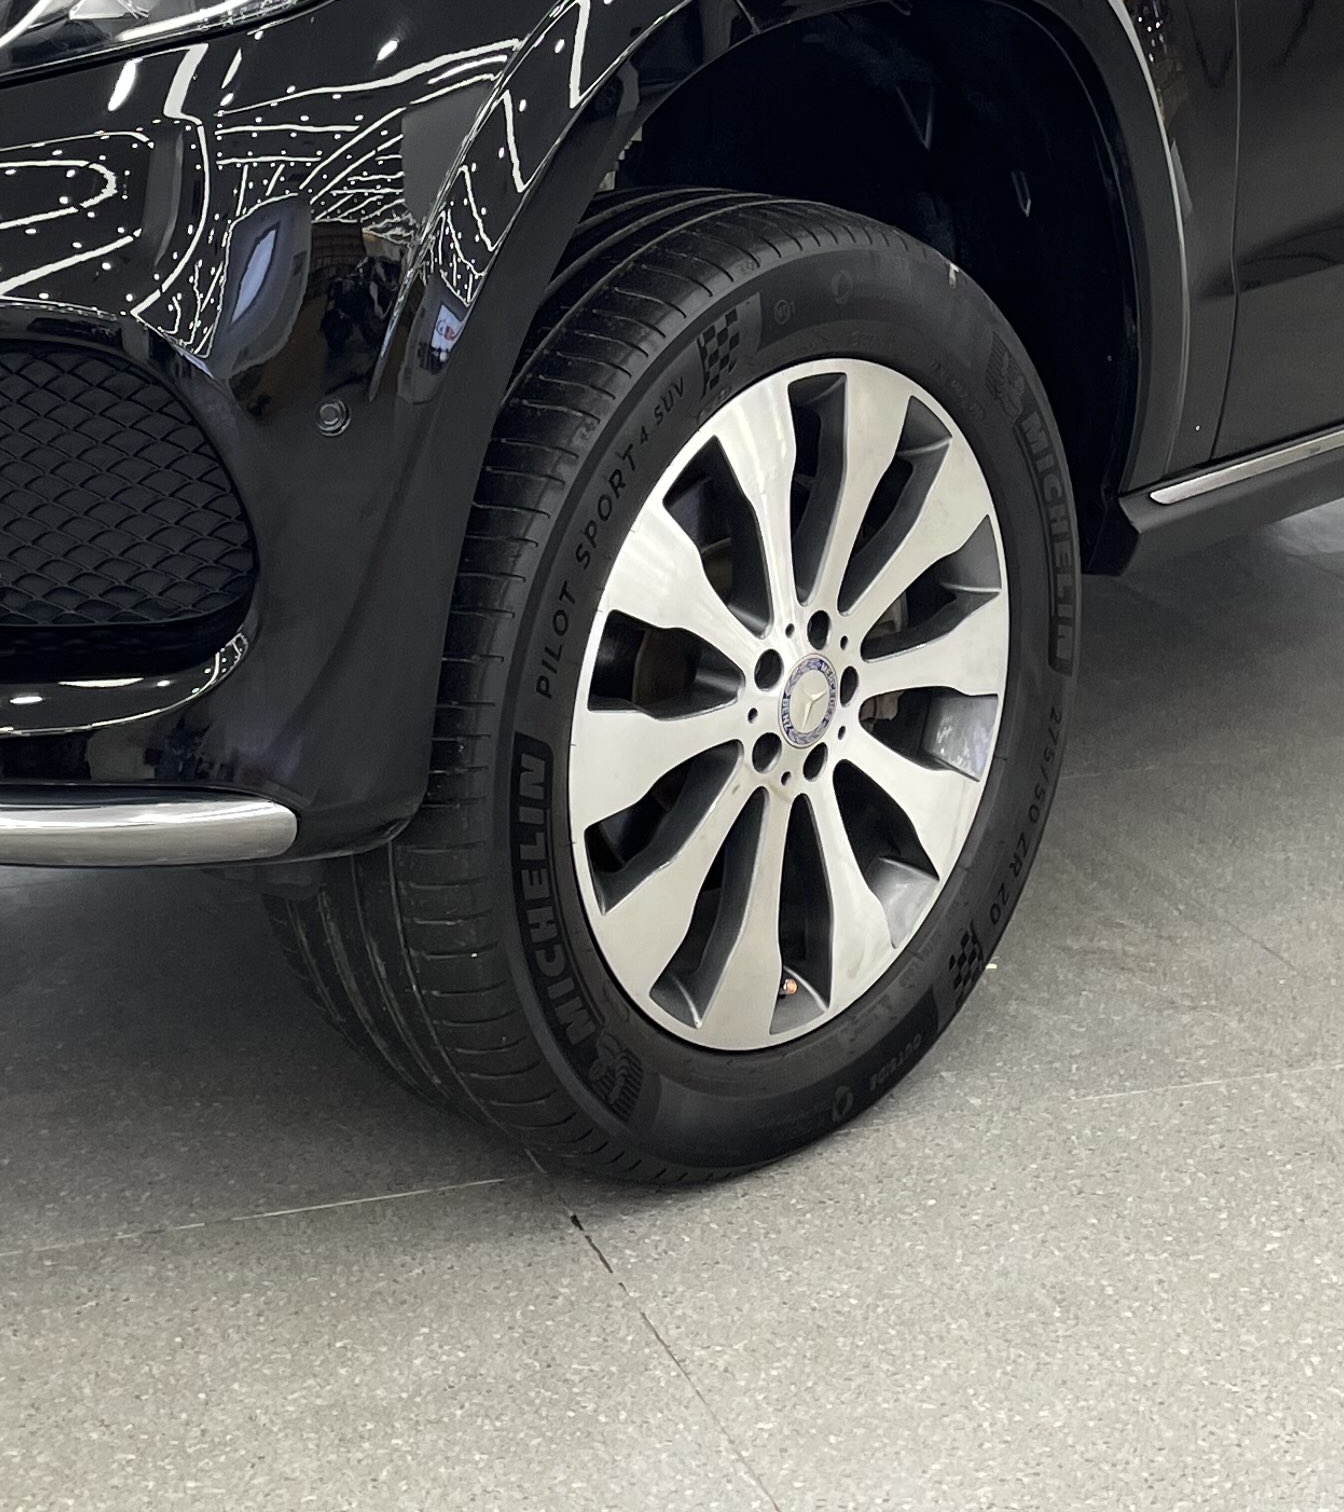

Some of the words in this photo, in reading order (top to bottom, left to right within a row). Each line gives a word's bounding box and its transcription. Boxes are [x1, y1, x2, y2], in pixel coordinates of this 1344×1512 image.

[536, 580, 577, 700] PILOT
[575, 443, 637, 571] SPORT
[639, 425, 650, 446] 4
[654, 376, 687, 424] SUV
[1020, 410, 1076, 670] MICHELIN
[1008, 831, 1031, 879] ZR
[1028, 706, 1062, 825] 275/50
[518, 752, 598, 1048] MICHELIN
[989, 884, 1011, 927] 20
